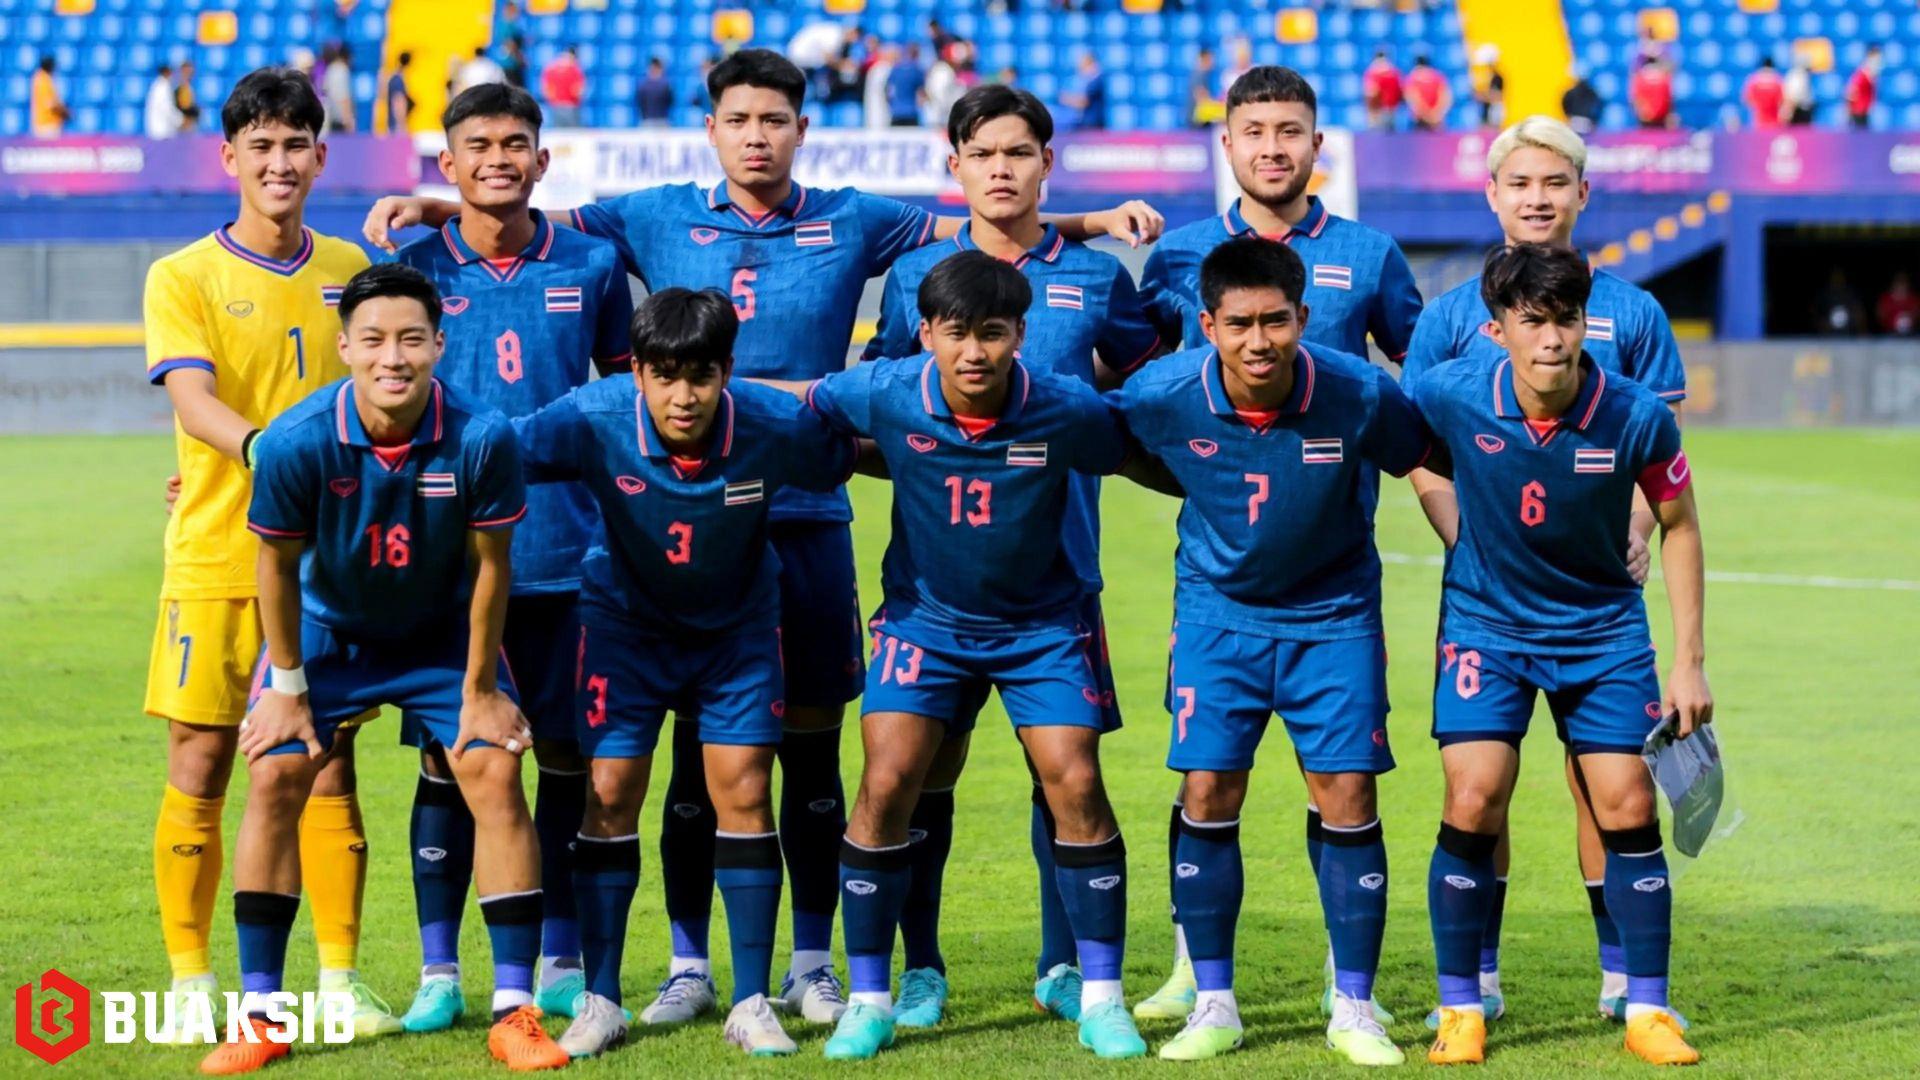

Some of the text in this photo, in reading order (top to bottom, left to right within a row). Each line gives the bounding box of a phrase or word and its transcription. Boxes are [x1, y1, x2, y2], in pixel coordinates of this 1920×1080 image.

[596, 142, 719, 178] THAILAN
[731, 268, 757, 322] 5
[288, 326, 304, 380] 1
[496, 329, 523, 384] 8
[945, 475, 992, 527] 13
[1244, 473, 1269, 526] 7
[1520, 480, 1546, 527] 6
[365, 523, 411, 568] 16
[666, 521, 693, 564] 3
[178, 635, 192, 688] 1
[881, 636, 924, 685] 13
[1456, 650, 1481, 699] 6
[586, 674, 608, 728] 3
[1177, 687, 1195, 743] 7
